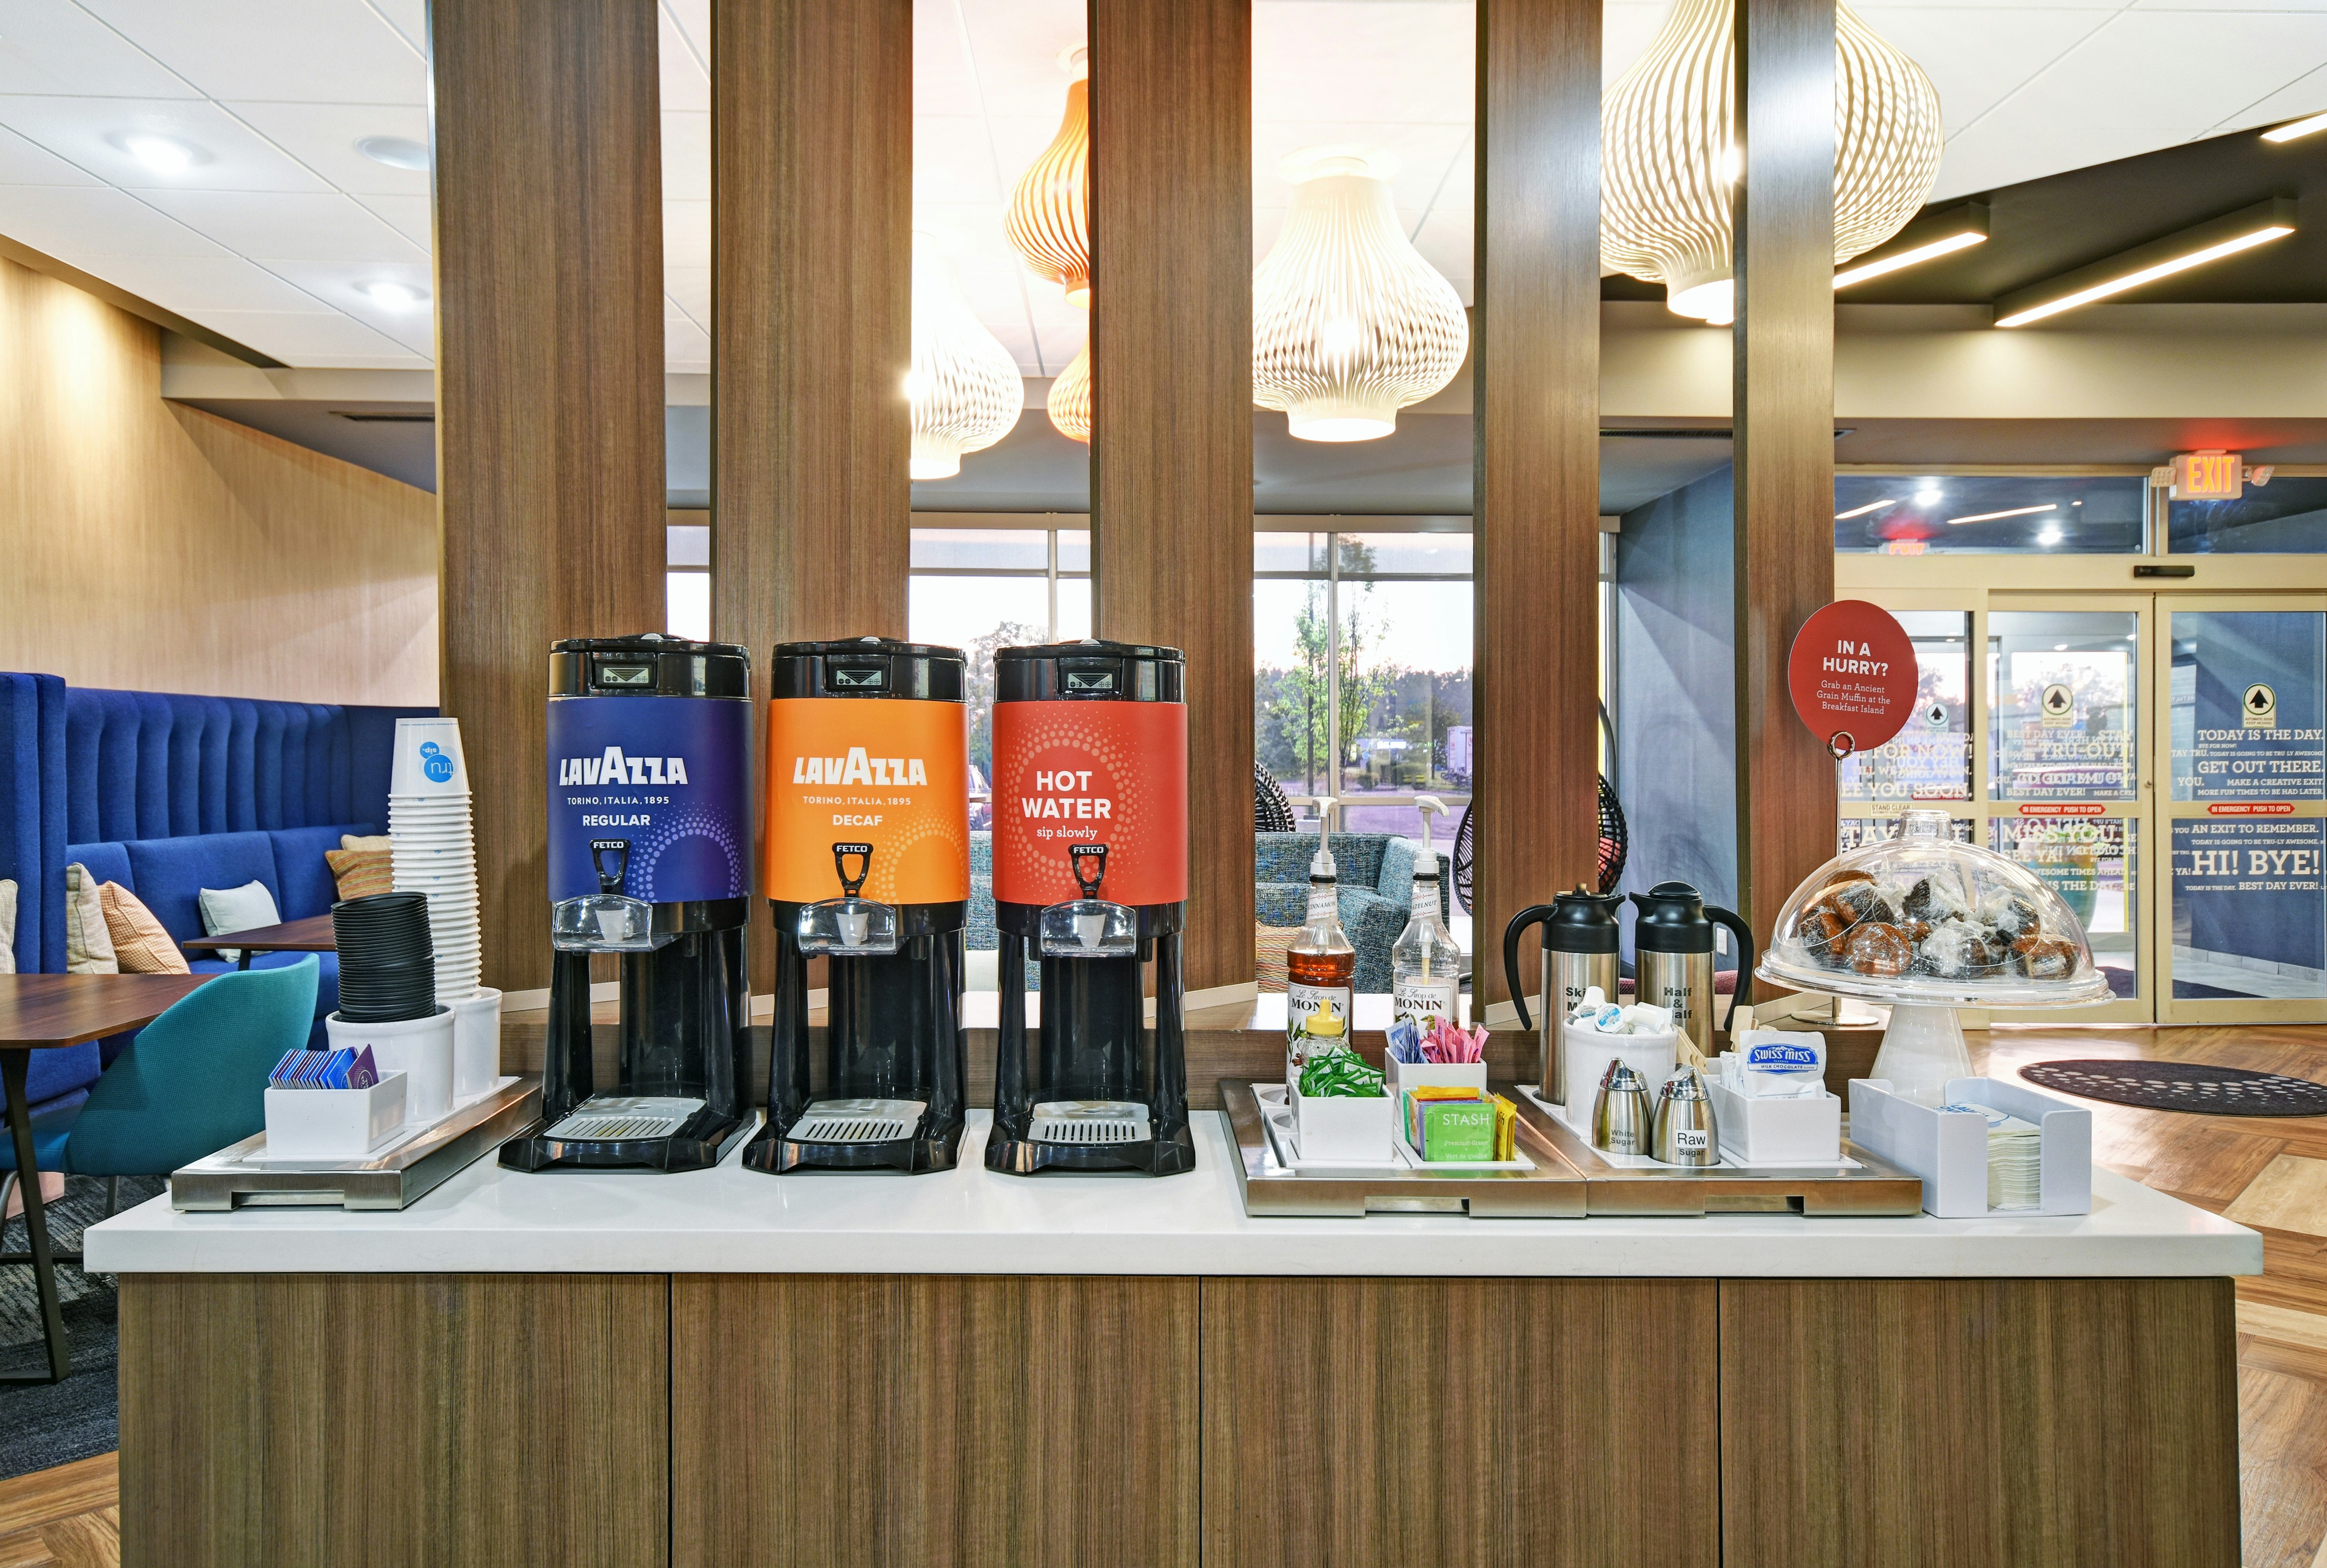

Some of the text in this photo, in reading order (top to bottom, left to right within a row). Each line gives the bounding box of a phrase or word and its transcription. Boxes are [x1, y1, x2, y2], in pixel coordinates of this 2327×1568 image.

[2187, 456, 2235, 493] EXIT
[1838, 640, 1871, 657] IN A
[1823, 657, 1888, 677] HURRY?
[1821, 680, 1840, 689] Grab
[1854, 683, 1885, 693] Ancient
[1817, 690, 1839, 700] Grain
[1841, 692, 1866, 702] Muffin
[1878, 695, 1890, 704] the
[1822, 701, 1884, 714] Breakfast Island
[2197, 729, 2324, 741] TODAY IS THE DAY.
[1873, 744, 1909, 758] FOR
[1917, 744, 1973, 759] NOW!
[430, 762, 453, 776] tru
[559, 746, 688, 786] LAVAZZA
[793, 747, 928, 786] LAVAZZA
[2198, 760, 2324, 773] GET OUT THERE.
[1037, 771, 1092, 792] HOT
[2177, 777, 2205, 786] YOU.
[1841, 782, 1972, 797] EE YOU SOON.
[2006, 788, 2030, 796] BEST
[2033, 788, 2054, 796] DAY
[2056, 787, 2085, 796] EVER!
[568, 796, 669, 806] TORINO, ITALIA, 1895
[803, 797, 911, 806] TORINO, ITALIA, 1895
[1021, 798, 1112, 819] WATER
[583, 814, 651, 826] REGULAR
[833, 815, 883, 826] DECAF
[1037, 825, 1098, 840] sip slowly
[2062, 824, 2120, 843] YOU.
[2191, 825, 2209, 833] AN
[2211, 824, 2236, 833] EXIT
[2238, 824, 2254, 833] TO
[2256, 824, 2319, 833] REMEMBER.
[2037, 849, 2062, 862] YA!
[2191, 850, 2238, 876] HI!
[2249, 850, 2319, 875] BYE!
[2175, 867, 2191, 876] YA!
[2062, 881, 2087, 890] THE
[2238, 882, 2264, 890] BEST
[2266, 882, 2287, 890] DAY
[2289, 881, 2318, 890] EVER!
[1296, 989, 1306, 997] Le
[1398, 988, 1407, 996] Le
[1407, 988, 1427, 1000] Sirop
[1566, 987, 1586, 997] Ski
[1664, 987, 1692, 996] Half
[1291, 997, 1342, 1012] MONN
[1395, 996, 1443, 1010] MONIN
[1673, 999, 1683, 1008] &
[1672, 1010, 1693, 1019] alf
[1443, 1113, 1489, 1125] STASH
[1496, 1110, 1505, 1125] ASH
[1611, 1137, 1635, 1146] Sugar
[1677, 1133, 1706, 1145] Raw
[1679, 1149, 1704, 1157] Sugar
